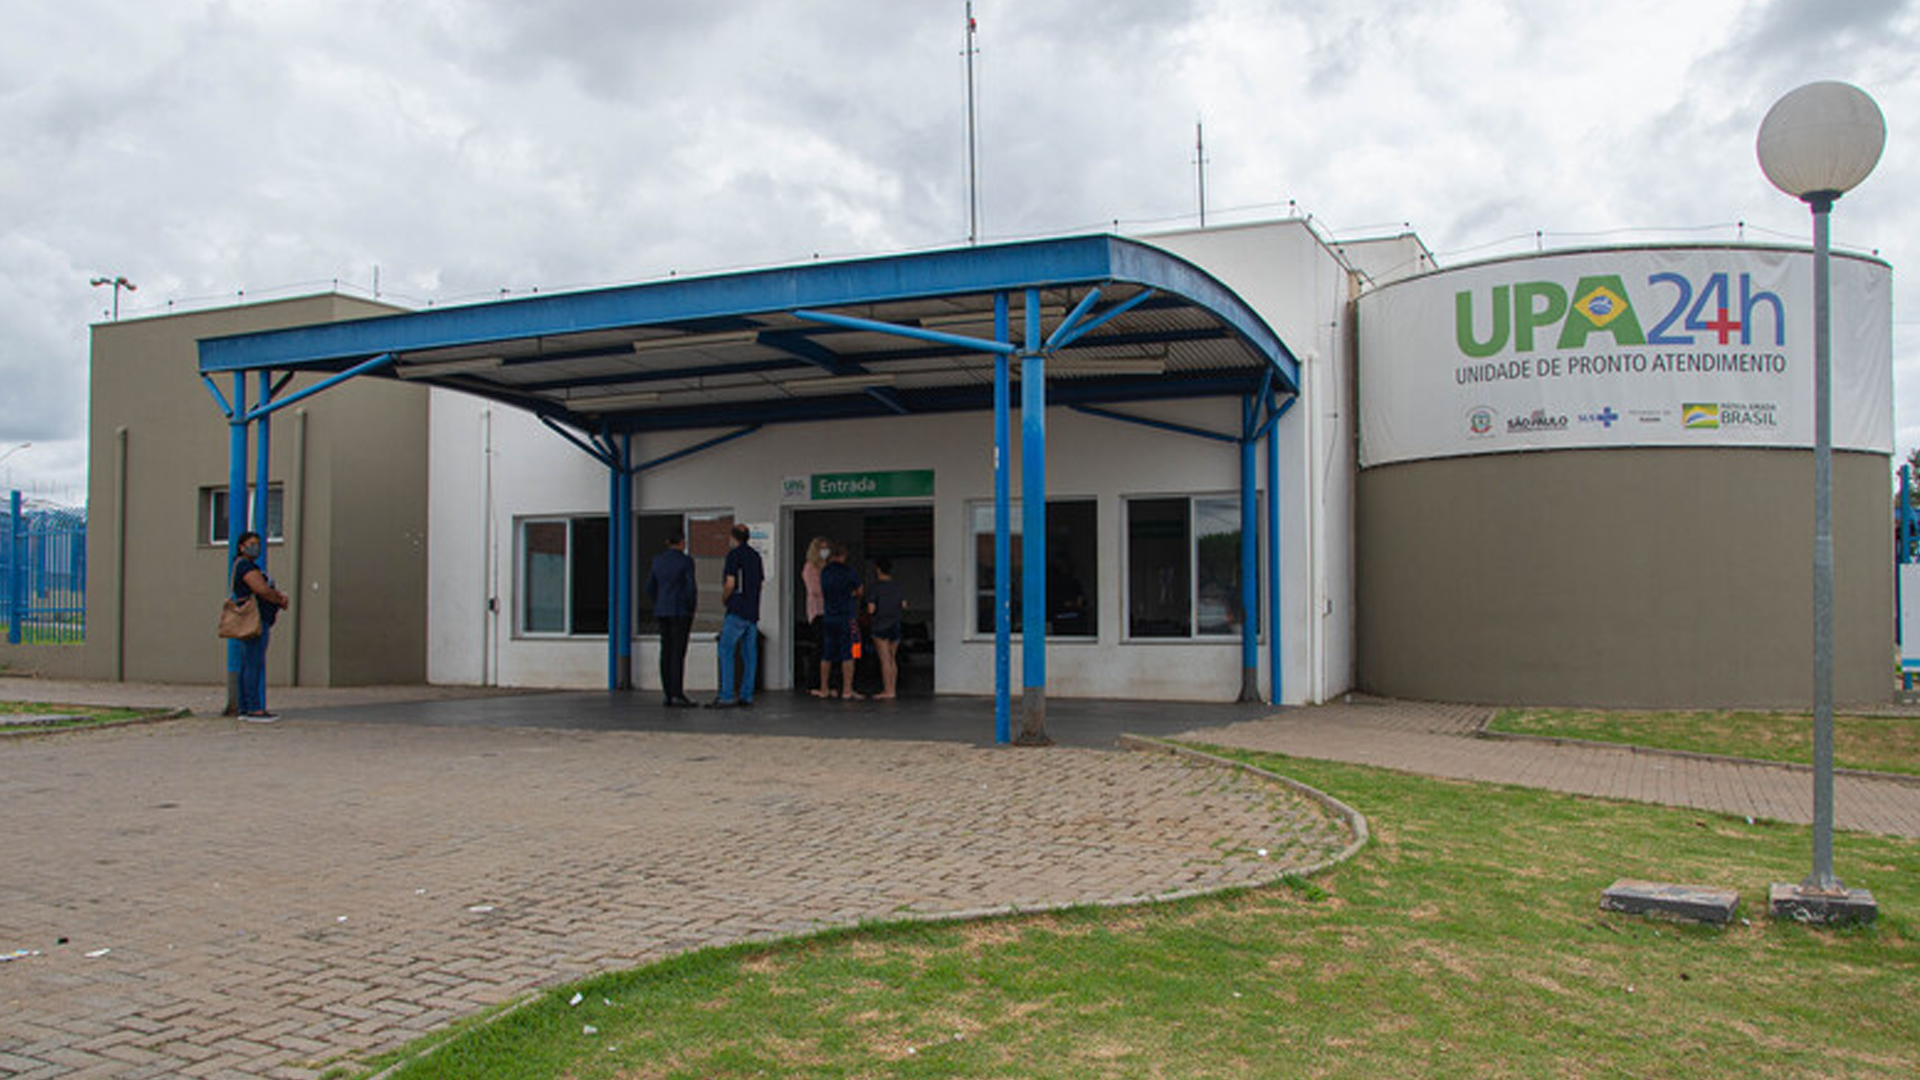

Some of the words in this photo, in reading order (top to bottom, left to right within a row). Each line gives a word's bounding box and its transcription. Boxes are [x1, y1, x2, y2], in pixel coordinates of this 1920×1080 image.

[1455, 274, 1647, 358] UPA
[1647, 272, 1786, 347] 24h
[1456, 360, 1531, 385] UNIDADE
[1537, 358, 1562, 377] DE
[1568, 354, 1647, 375] PRONTO
[1652, 353, 1787, 373] ATENDIMENTO
[1531, 415, 1568, 427] PAULO
[1721, 410, 1777, 426] BRASIL
[820, 476, 876, 493] Entrada
